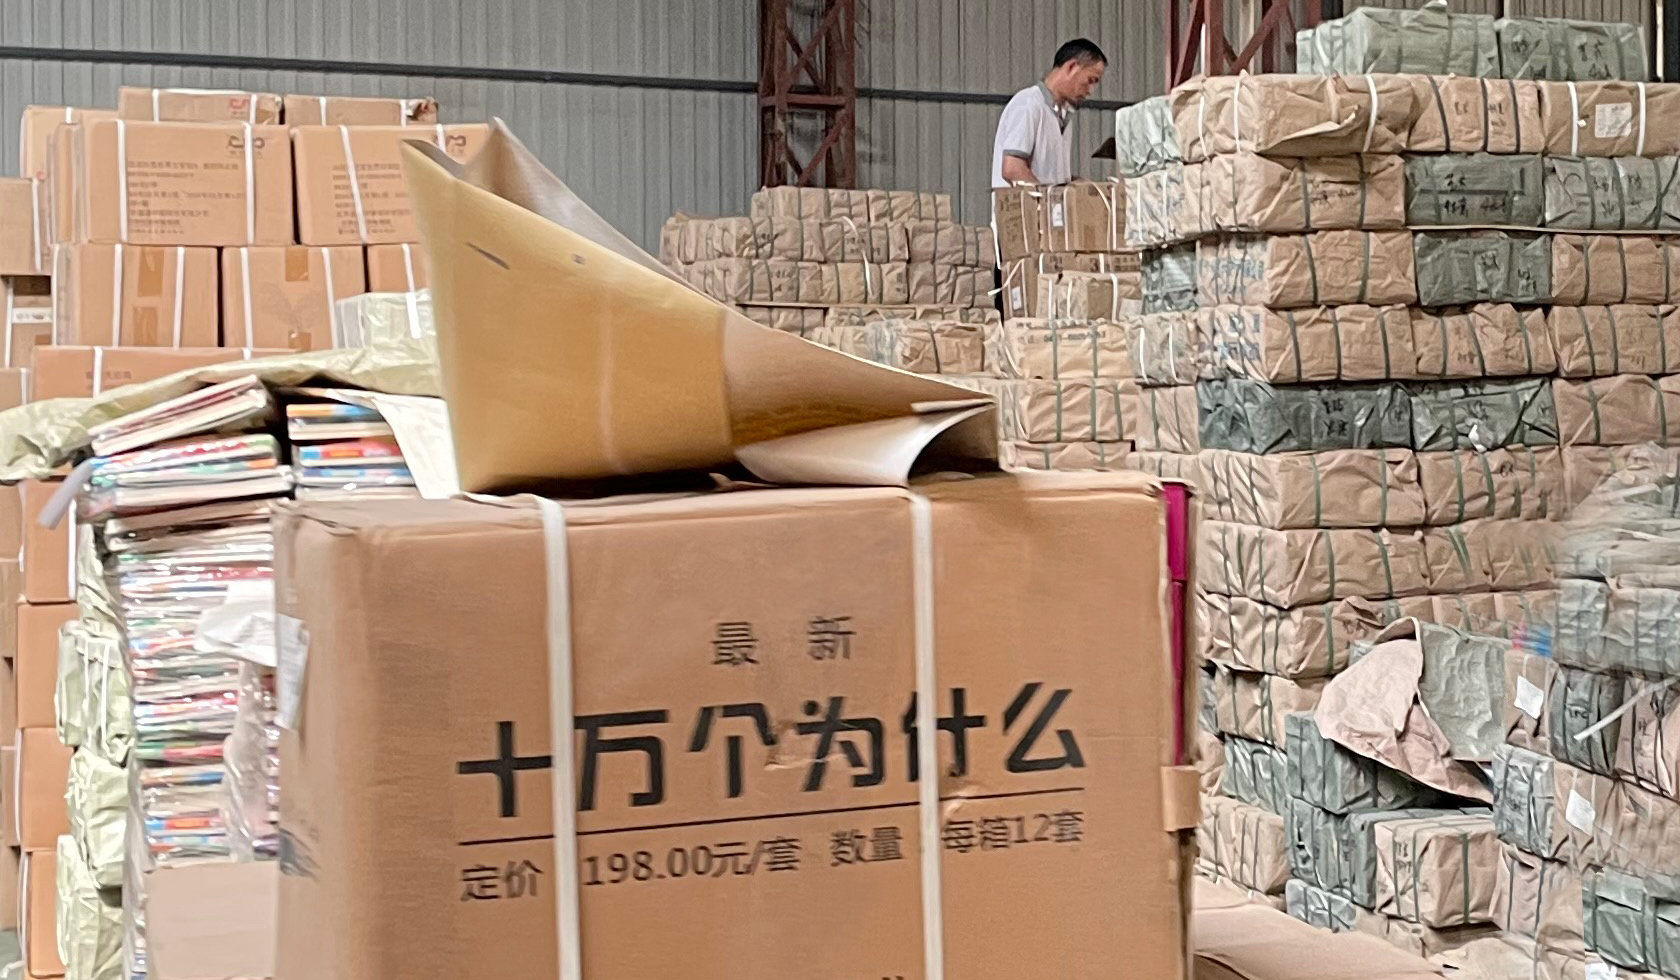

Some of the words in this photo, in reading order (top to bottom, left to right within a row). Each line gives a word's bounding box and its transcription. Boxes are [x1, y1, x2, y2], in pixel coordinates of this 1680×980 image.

[710, 615, 857, 668] 最新
[456, 681, 1086, 818] 十万个为什么
[459, 859, 544, 902] 定价
[941, 808, 1085, 854] 每箱12套
